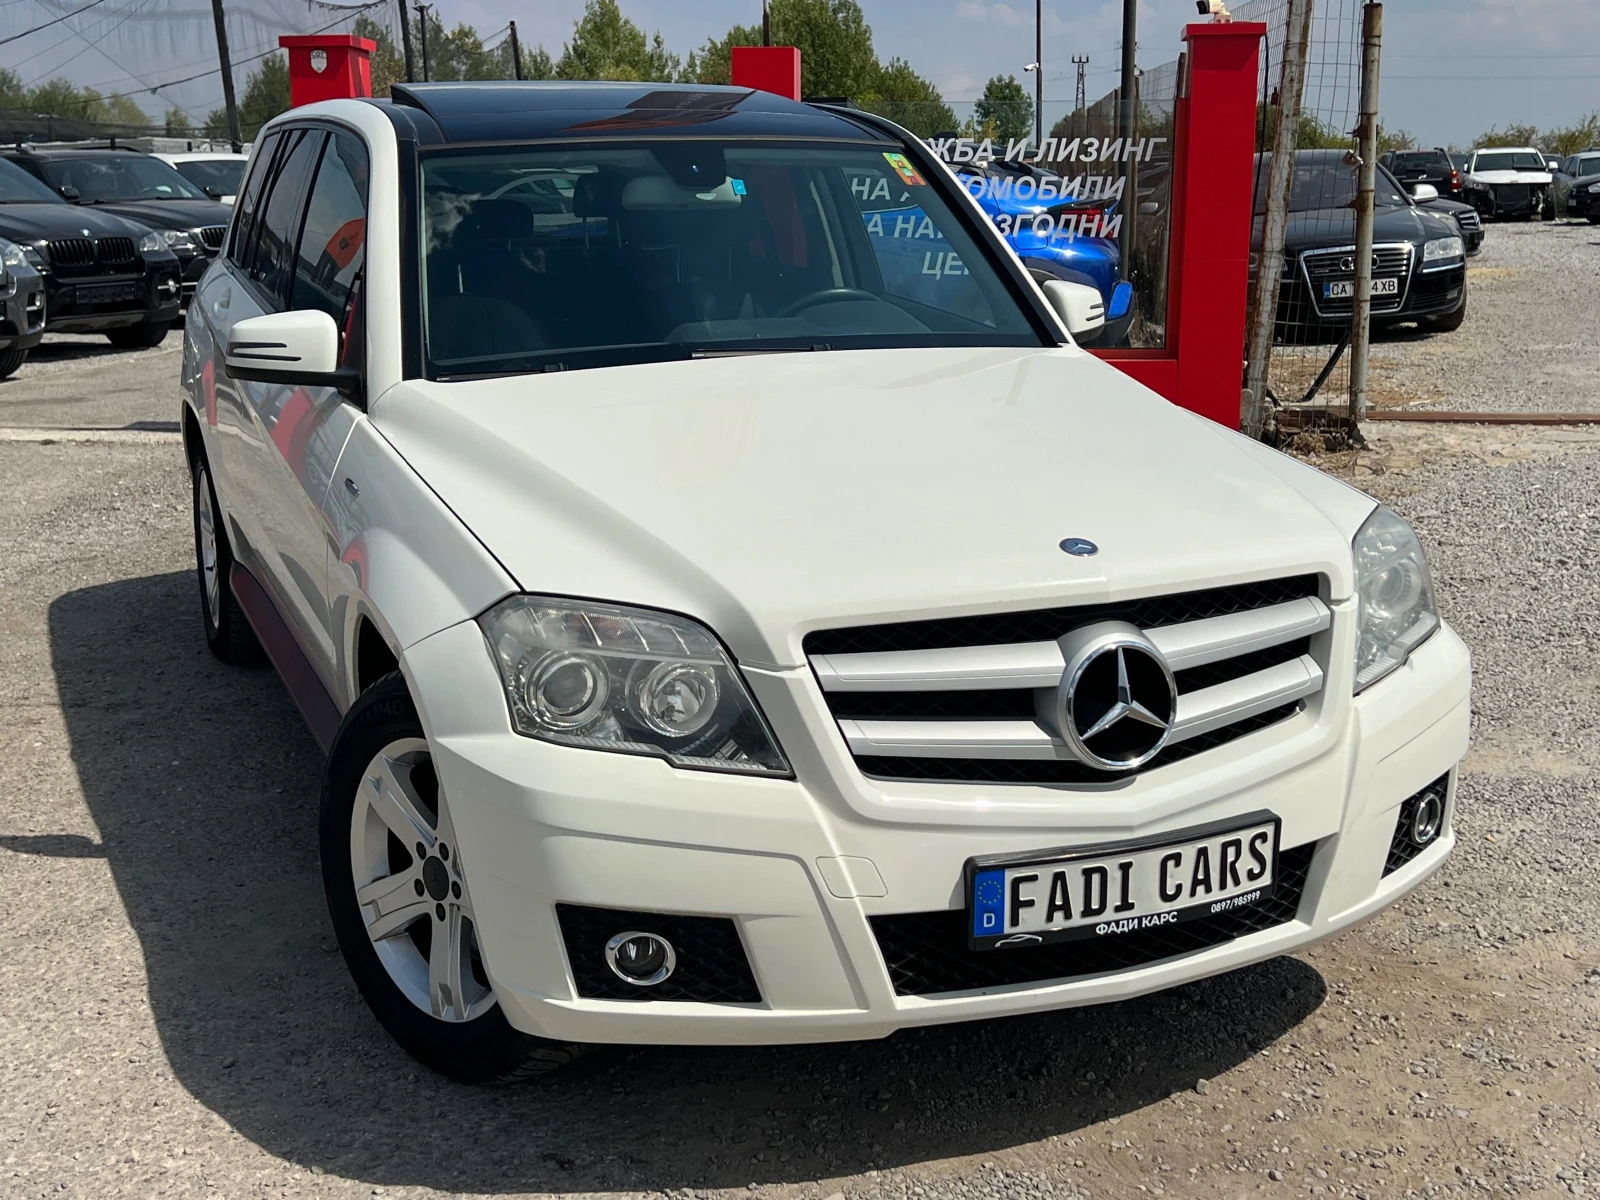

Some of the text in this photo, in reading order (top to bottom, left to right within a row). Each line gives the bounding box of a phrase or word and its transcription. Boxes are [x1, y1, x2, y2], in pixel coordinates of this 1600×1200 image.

[928, 137, 1168, 162] ЖБА И ЛИЗИНГ
[851, 175, 1127, 201] НА ОМОБИЛИ
[863, 213, 1123, 245] А НА ЗГОДНИ
[921, 251, 970, 281] ЦЕ
[1381, 280, 1396, 292] XB
[983, 830, 1269, 928] D FADI CARS
[1211, 890, 1261, 913] 0897/985999
[1095, 911, 1178, 936] ФАДИ КАРС
